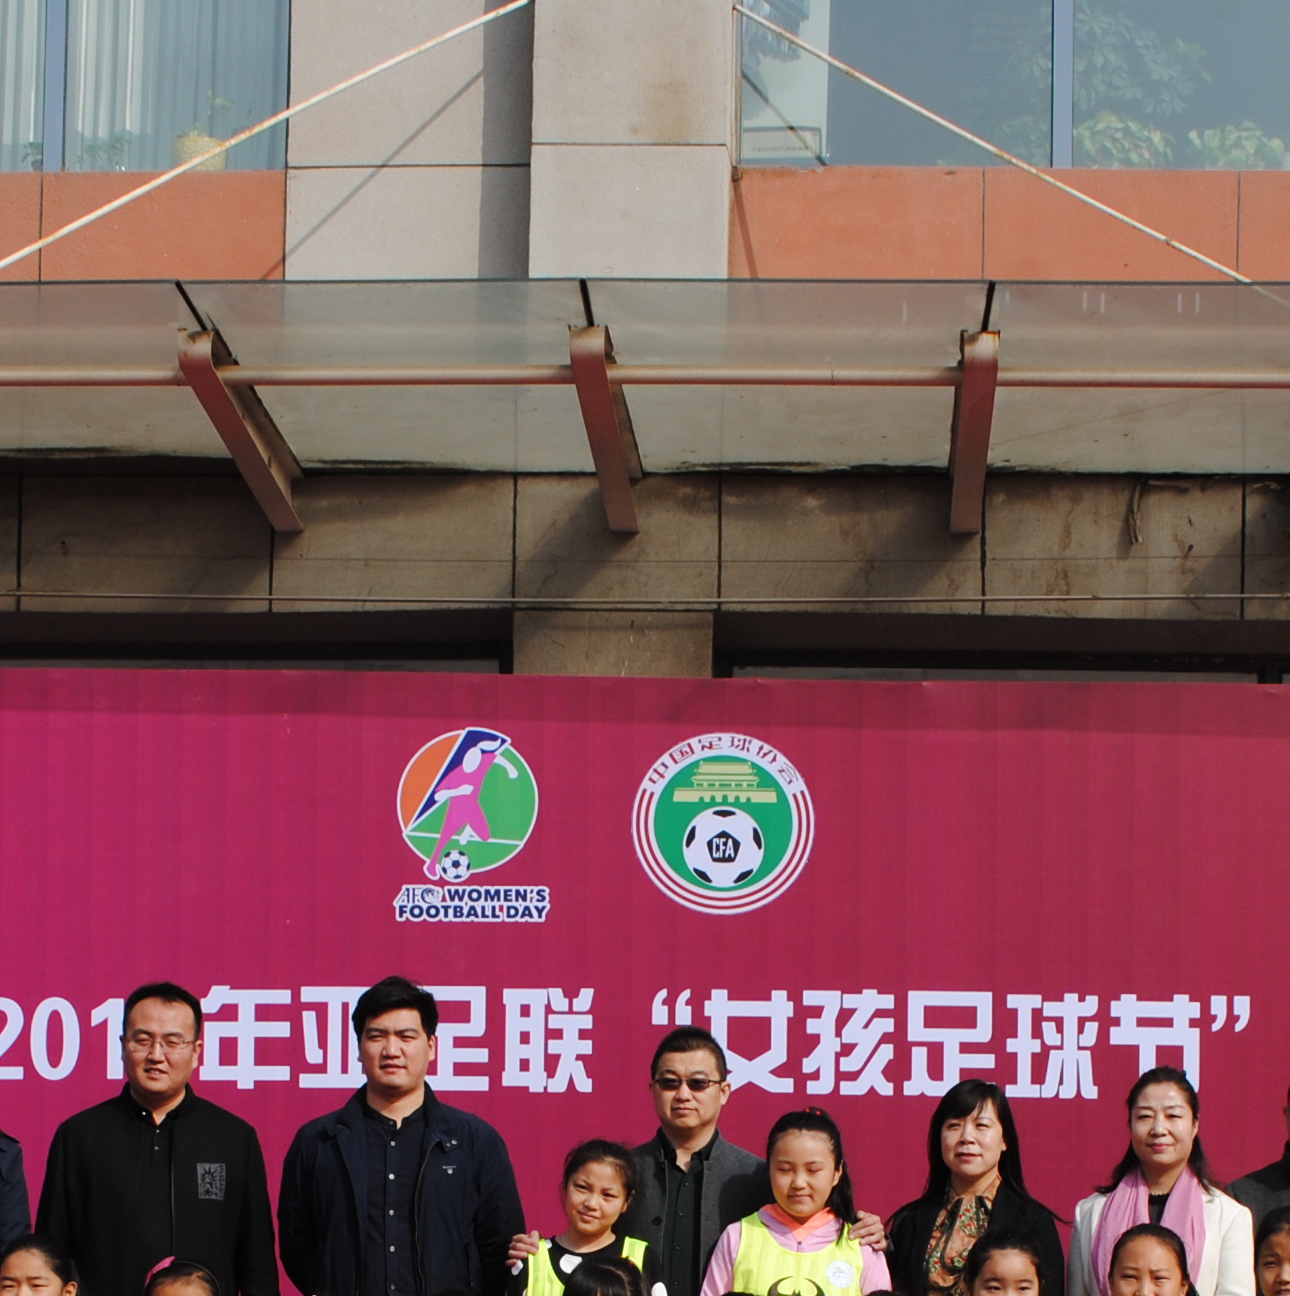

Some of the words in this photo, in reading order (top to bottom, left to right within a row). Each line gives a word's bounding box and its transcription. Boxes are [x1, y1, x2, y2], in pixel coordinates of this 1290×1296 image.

[647, 734, 799, 787] 中国足球协会
[712, 837, 735, 859] CFA
[446, 887, 547, 903] WOMEN'S
[398, 904, 501, 919] FOOTBALL
[506, 904, 547, 919] DAY
